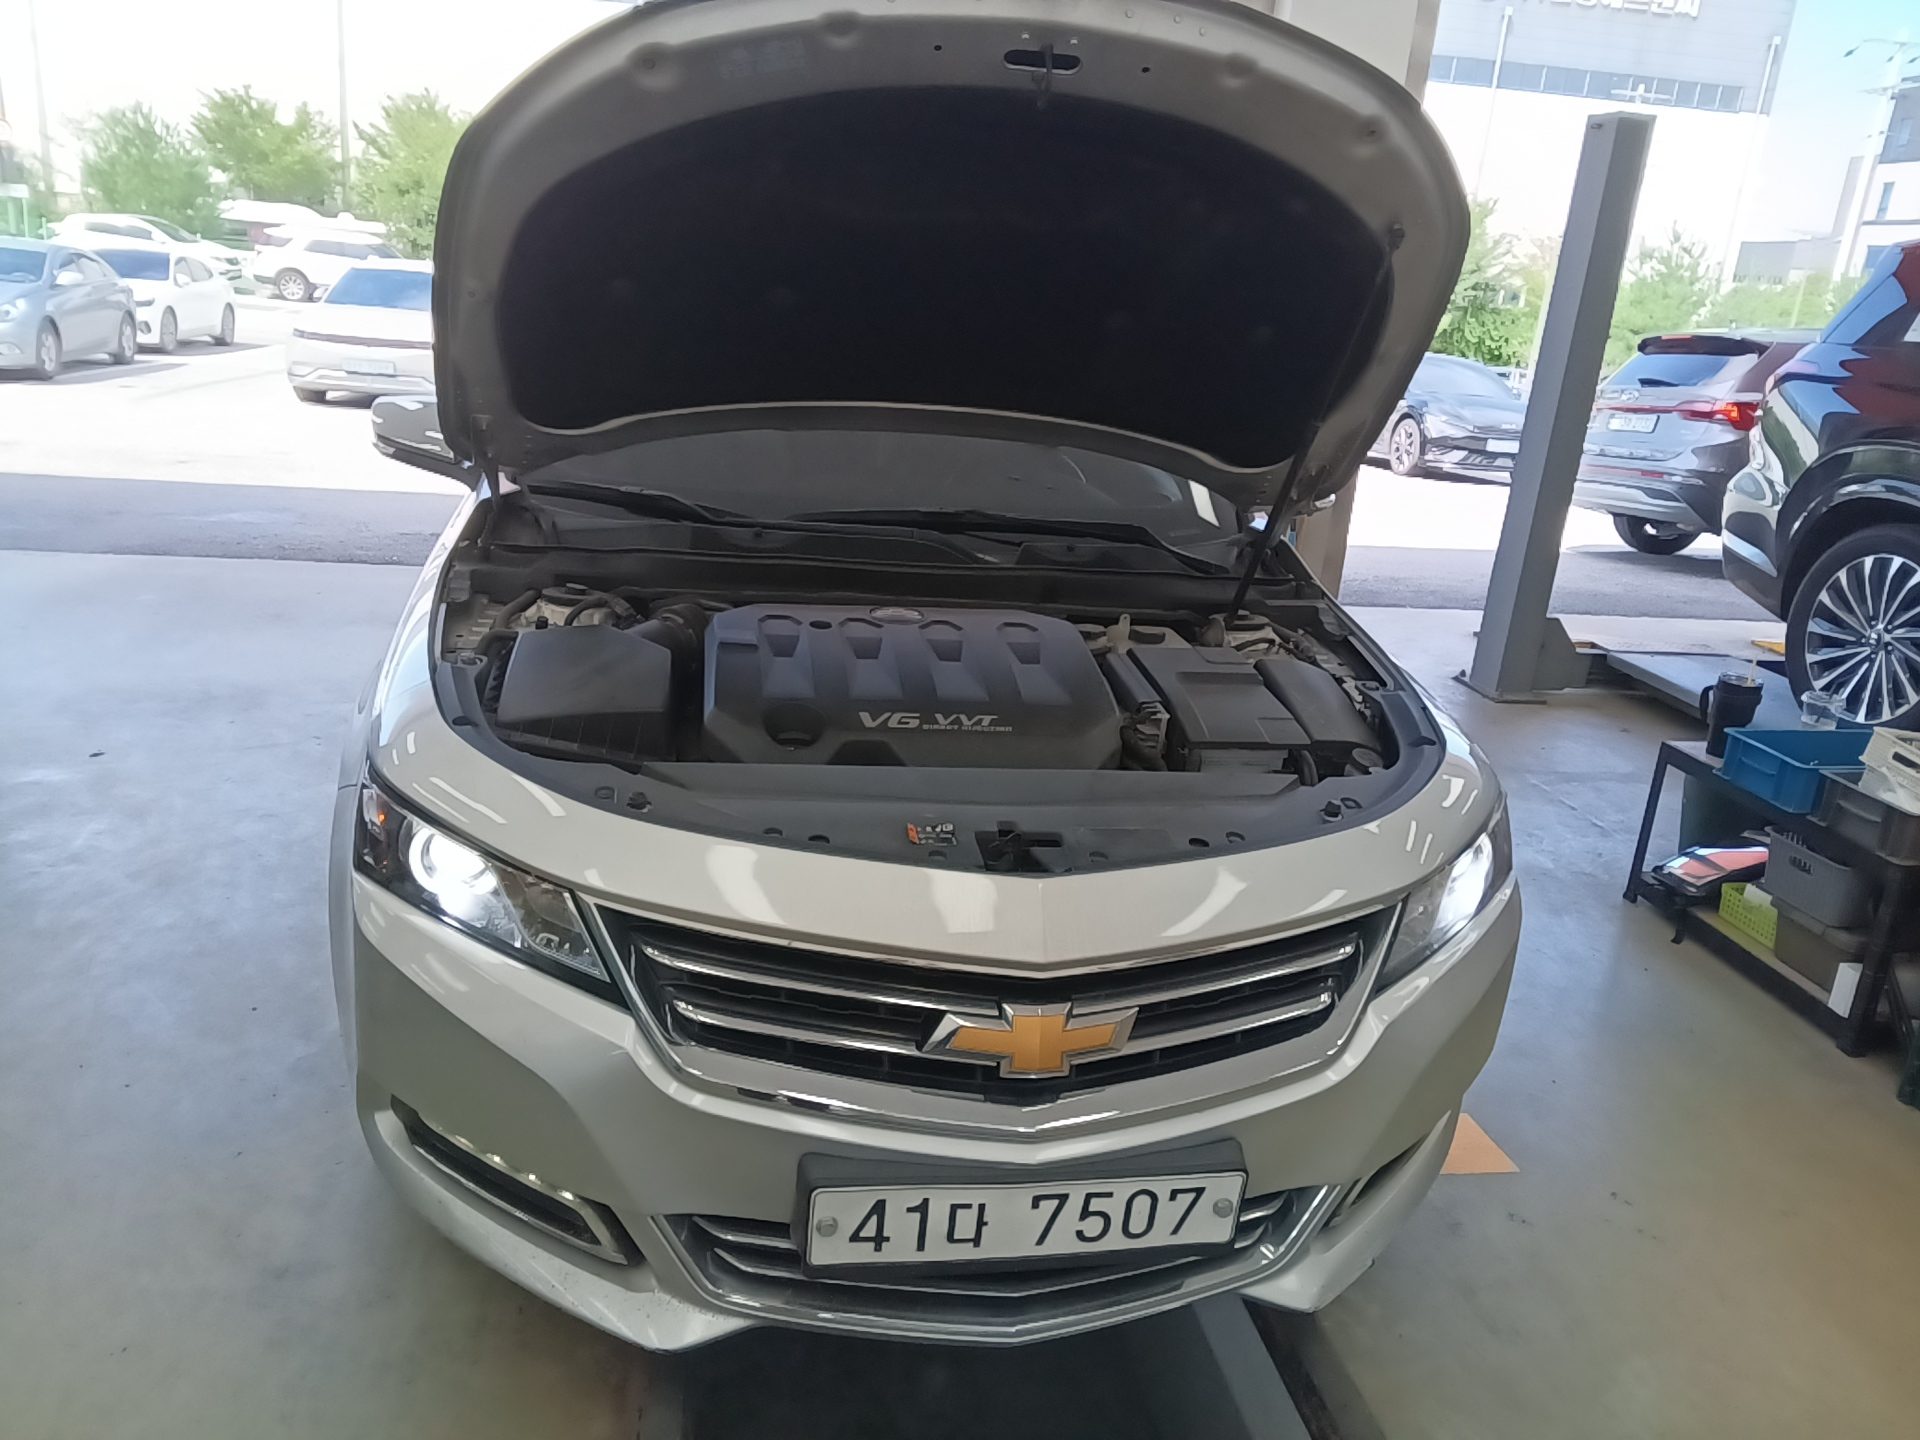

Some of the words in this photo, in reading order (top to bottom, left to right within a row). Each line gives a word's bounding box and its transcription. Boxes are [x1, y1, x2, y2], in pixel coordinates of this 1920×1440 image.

[858, 711, 921, 729] V6
[934, 713, 999, 726] VVT
[848, 1197, 989, 1253] 41다
[1030, 1186, 1206, 1247] 7507
